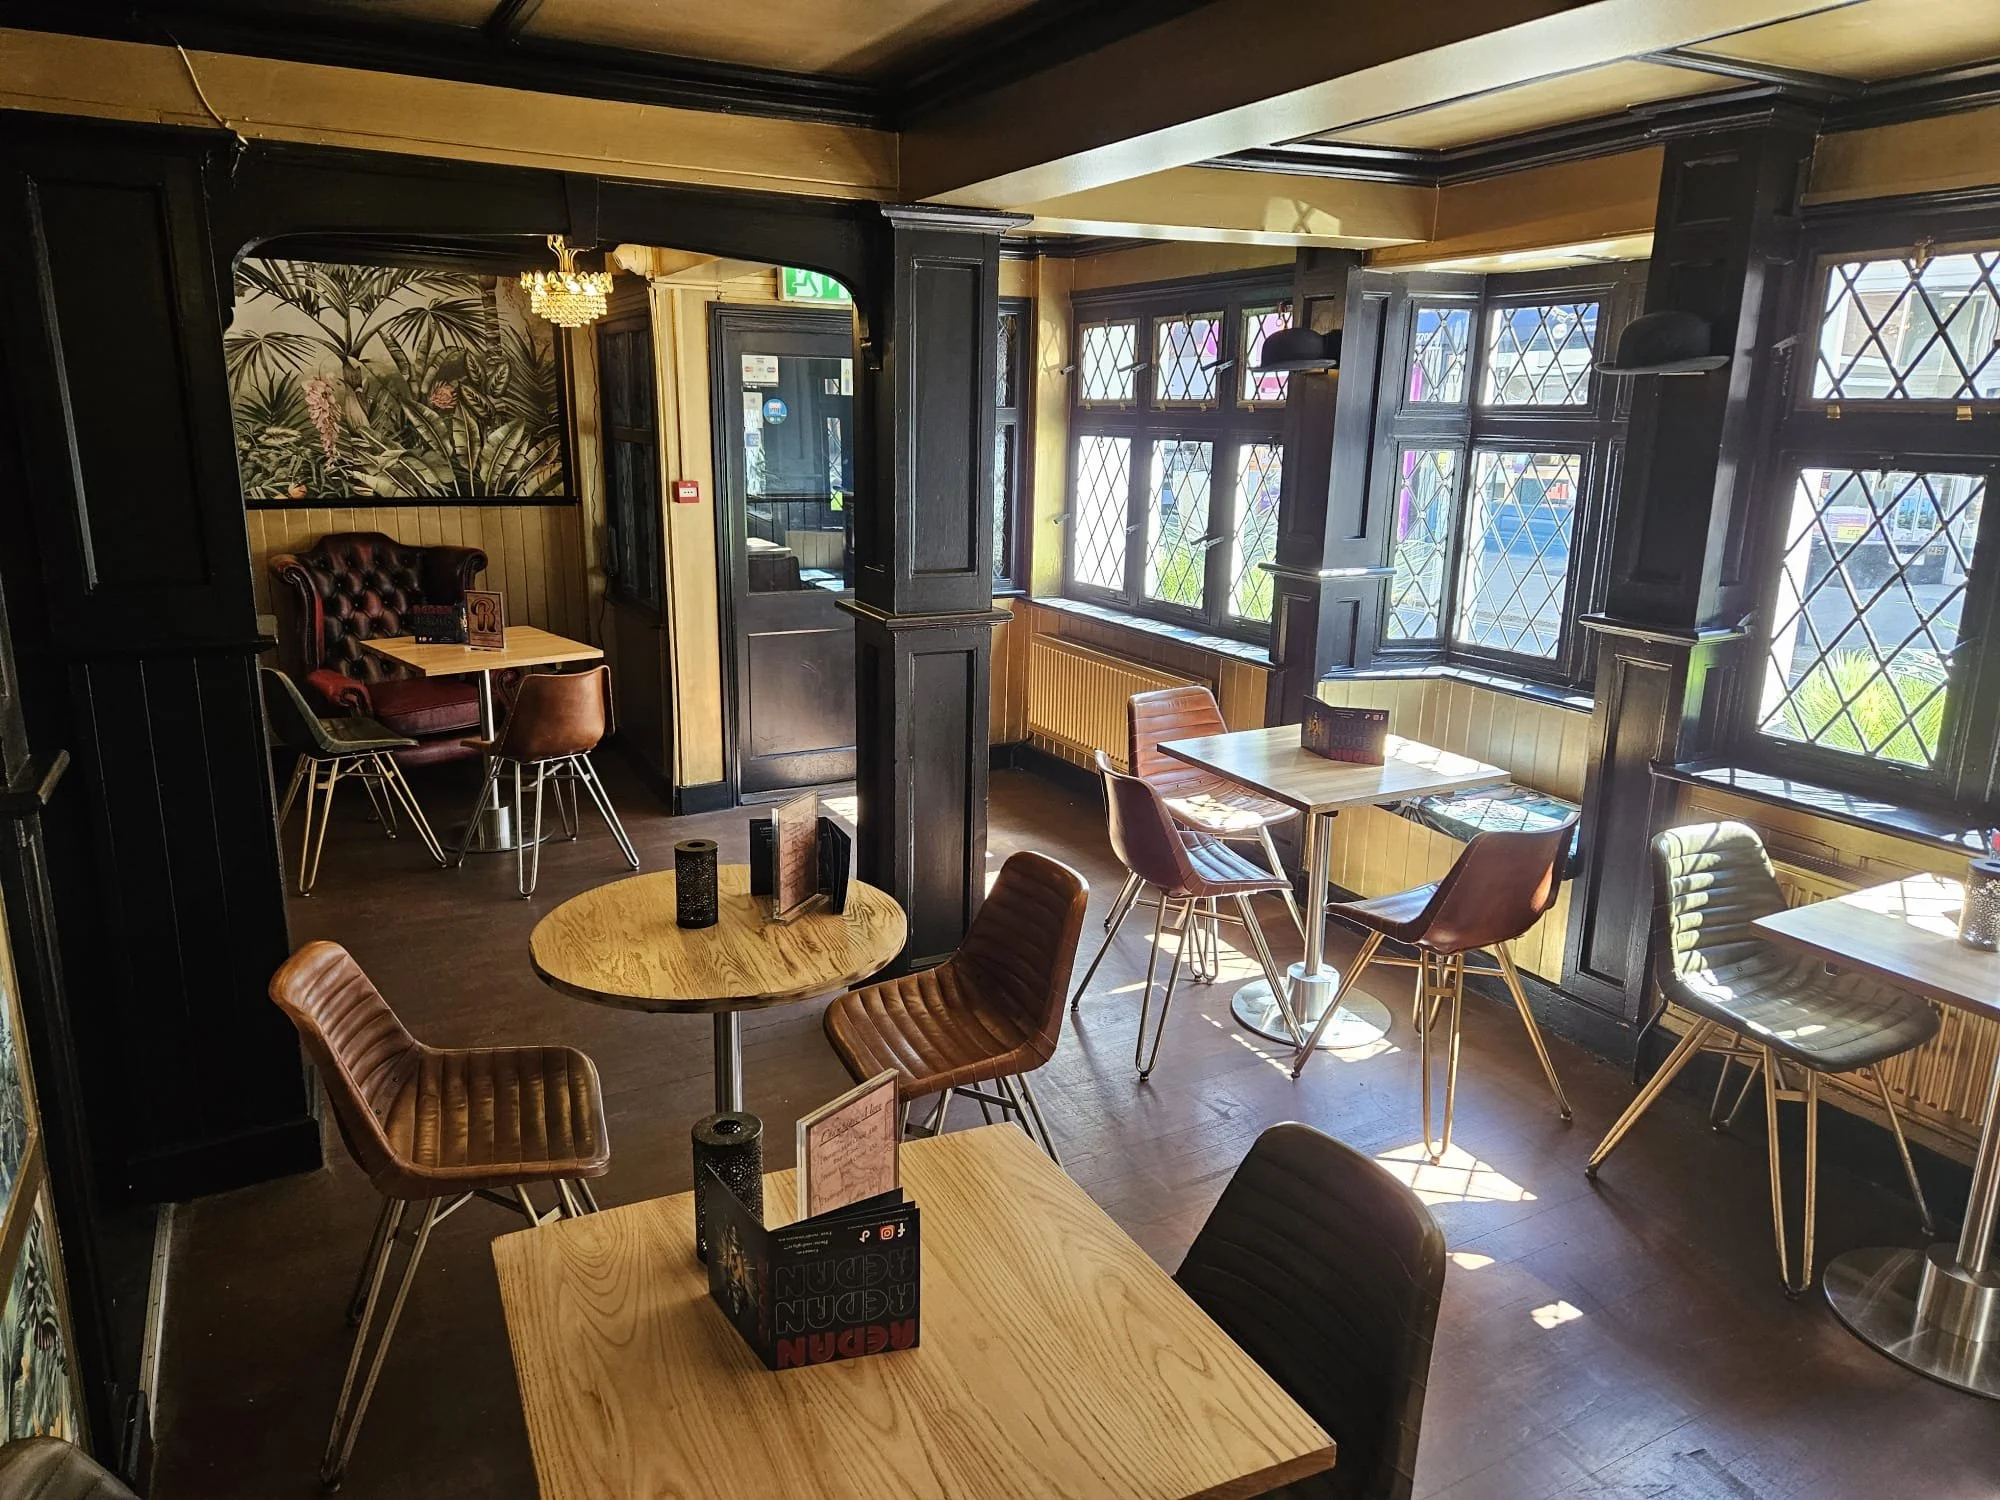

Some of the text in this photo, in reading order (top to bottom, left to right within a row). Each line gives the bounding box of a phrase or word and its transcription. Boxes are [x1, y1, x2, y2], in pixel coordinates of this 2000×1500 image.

[775, 1246, 916, 1299] REDAN
[775, 1282, 916, 1334] REDAN
[777, 1318, 916, 1368] REDAN
